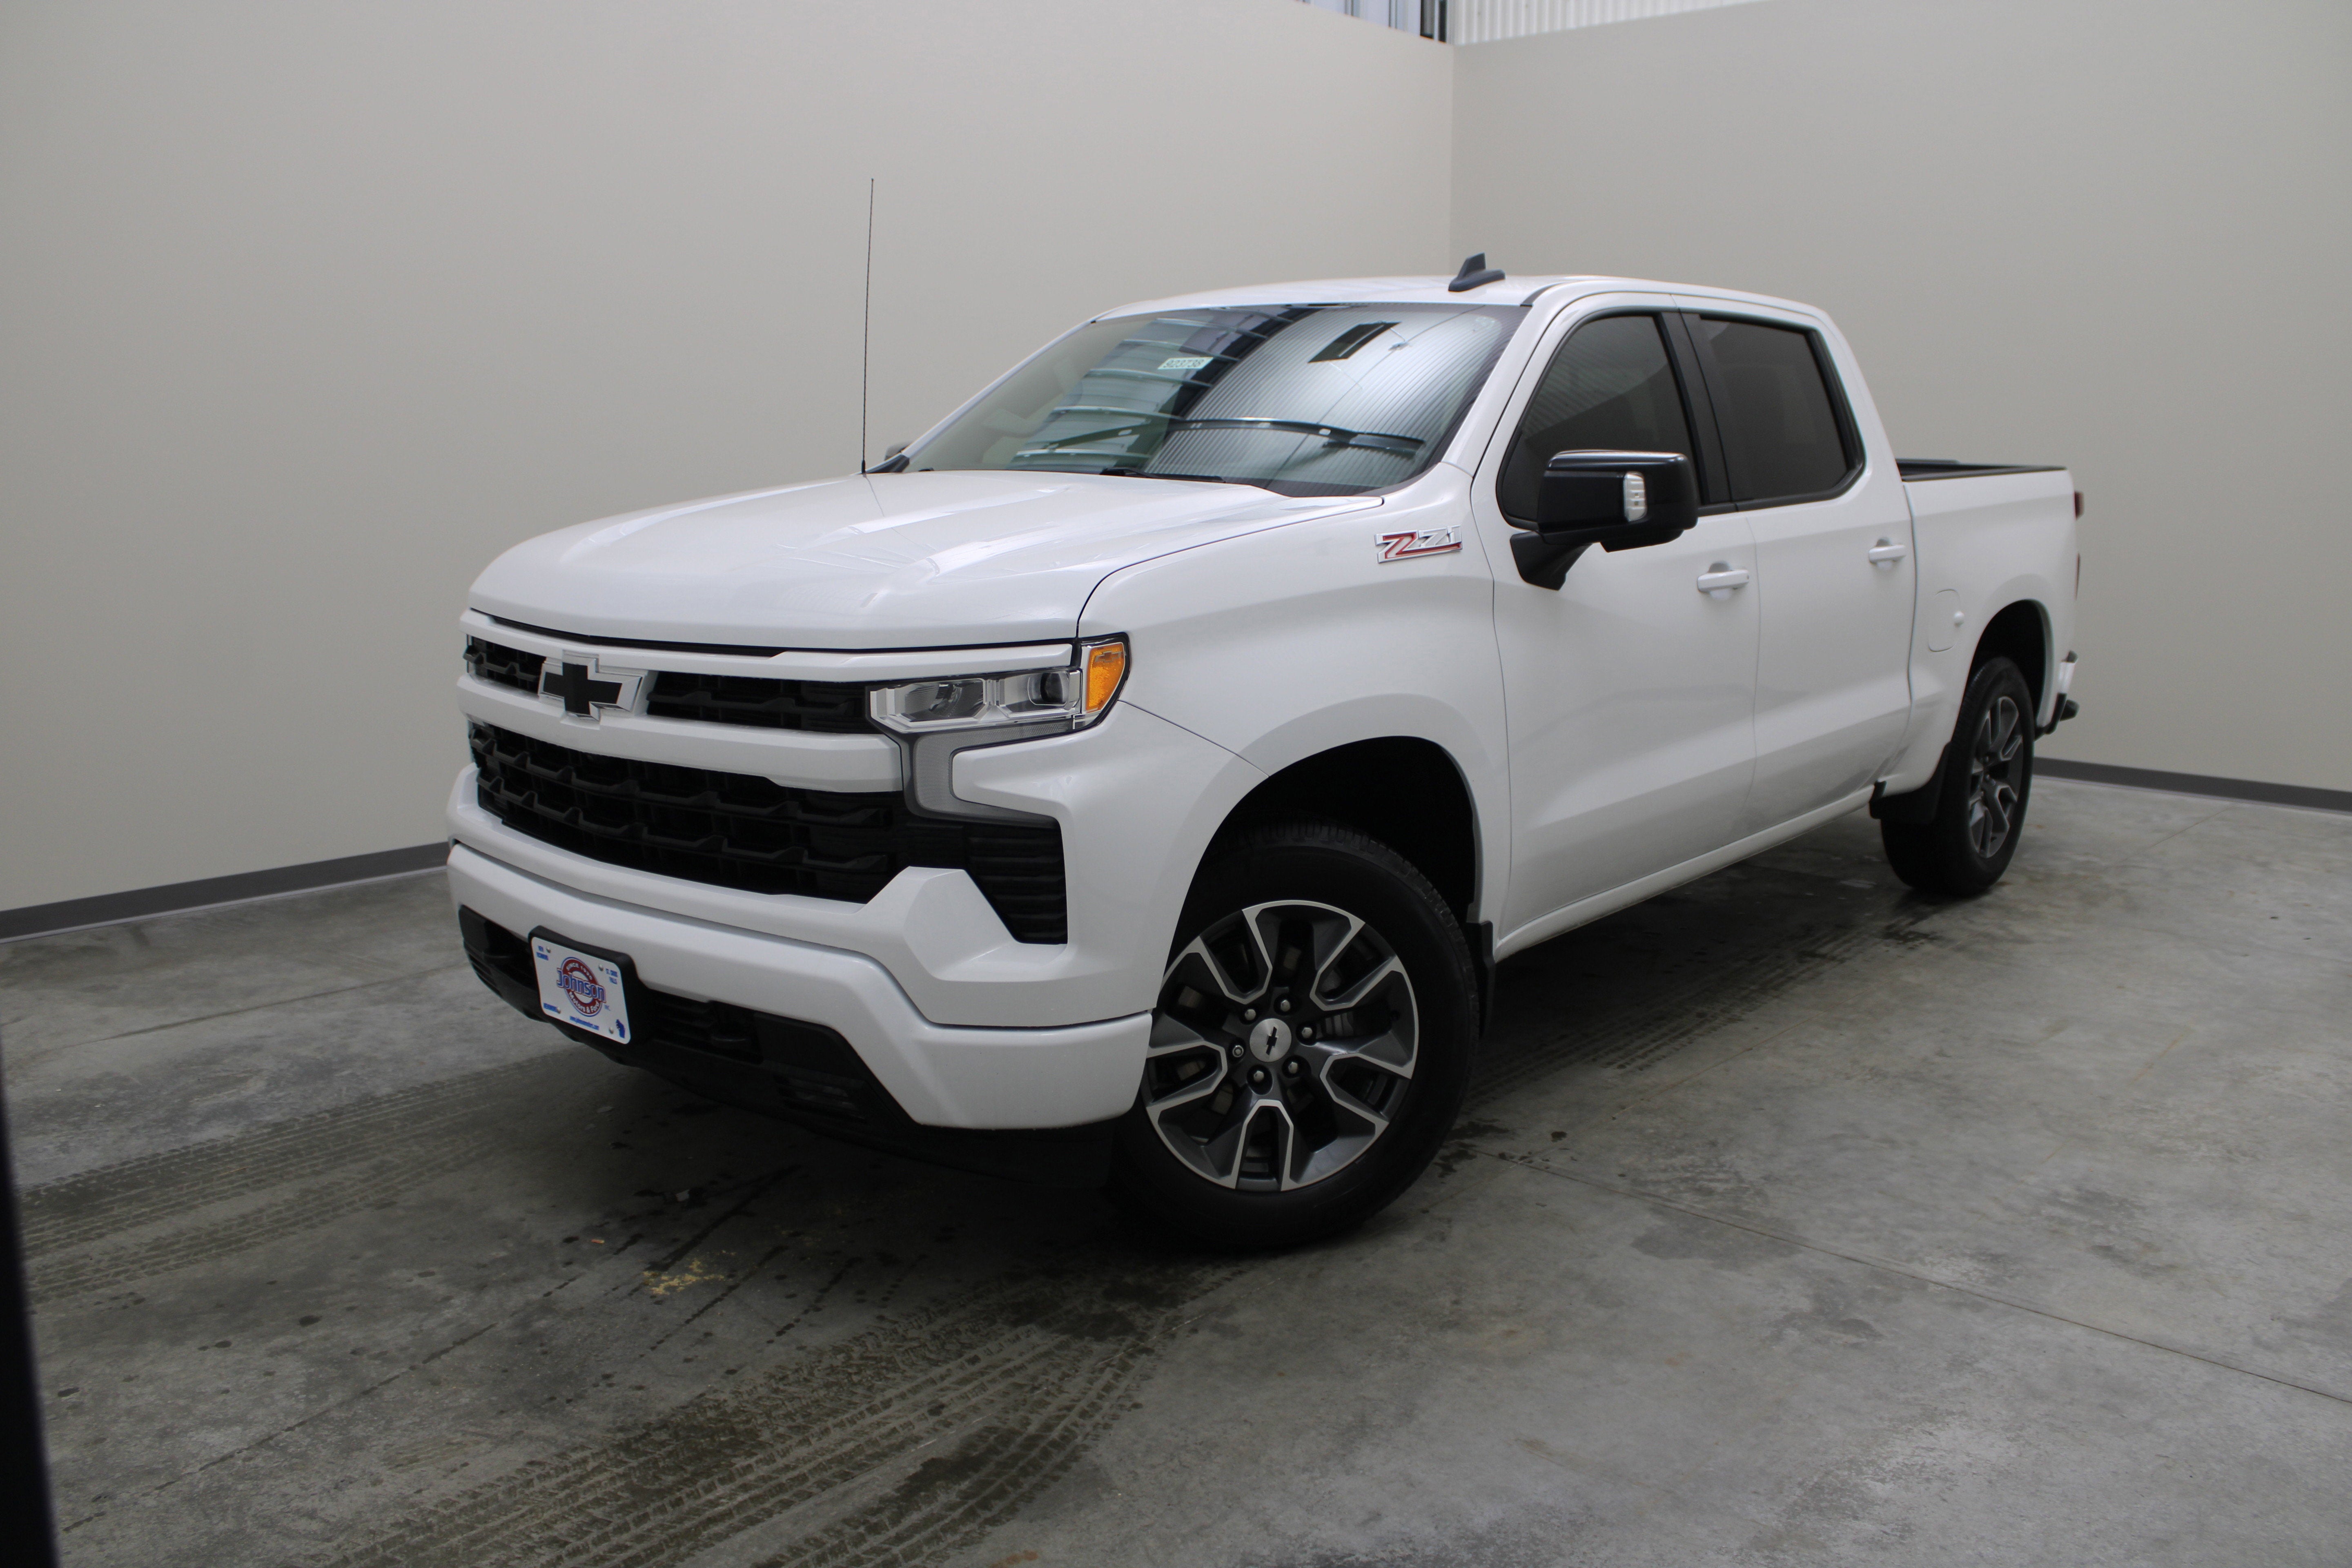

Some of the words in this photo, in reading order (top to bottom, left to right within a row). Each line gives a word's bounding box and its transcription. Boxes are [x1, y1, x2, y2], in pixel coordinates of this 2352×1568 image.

[1374, 524, 1463, 564] Z71
[566, 963, 579, 971] SINCE
[557, 968, 606, 1003] Johnson
